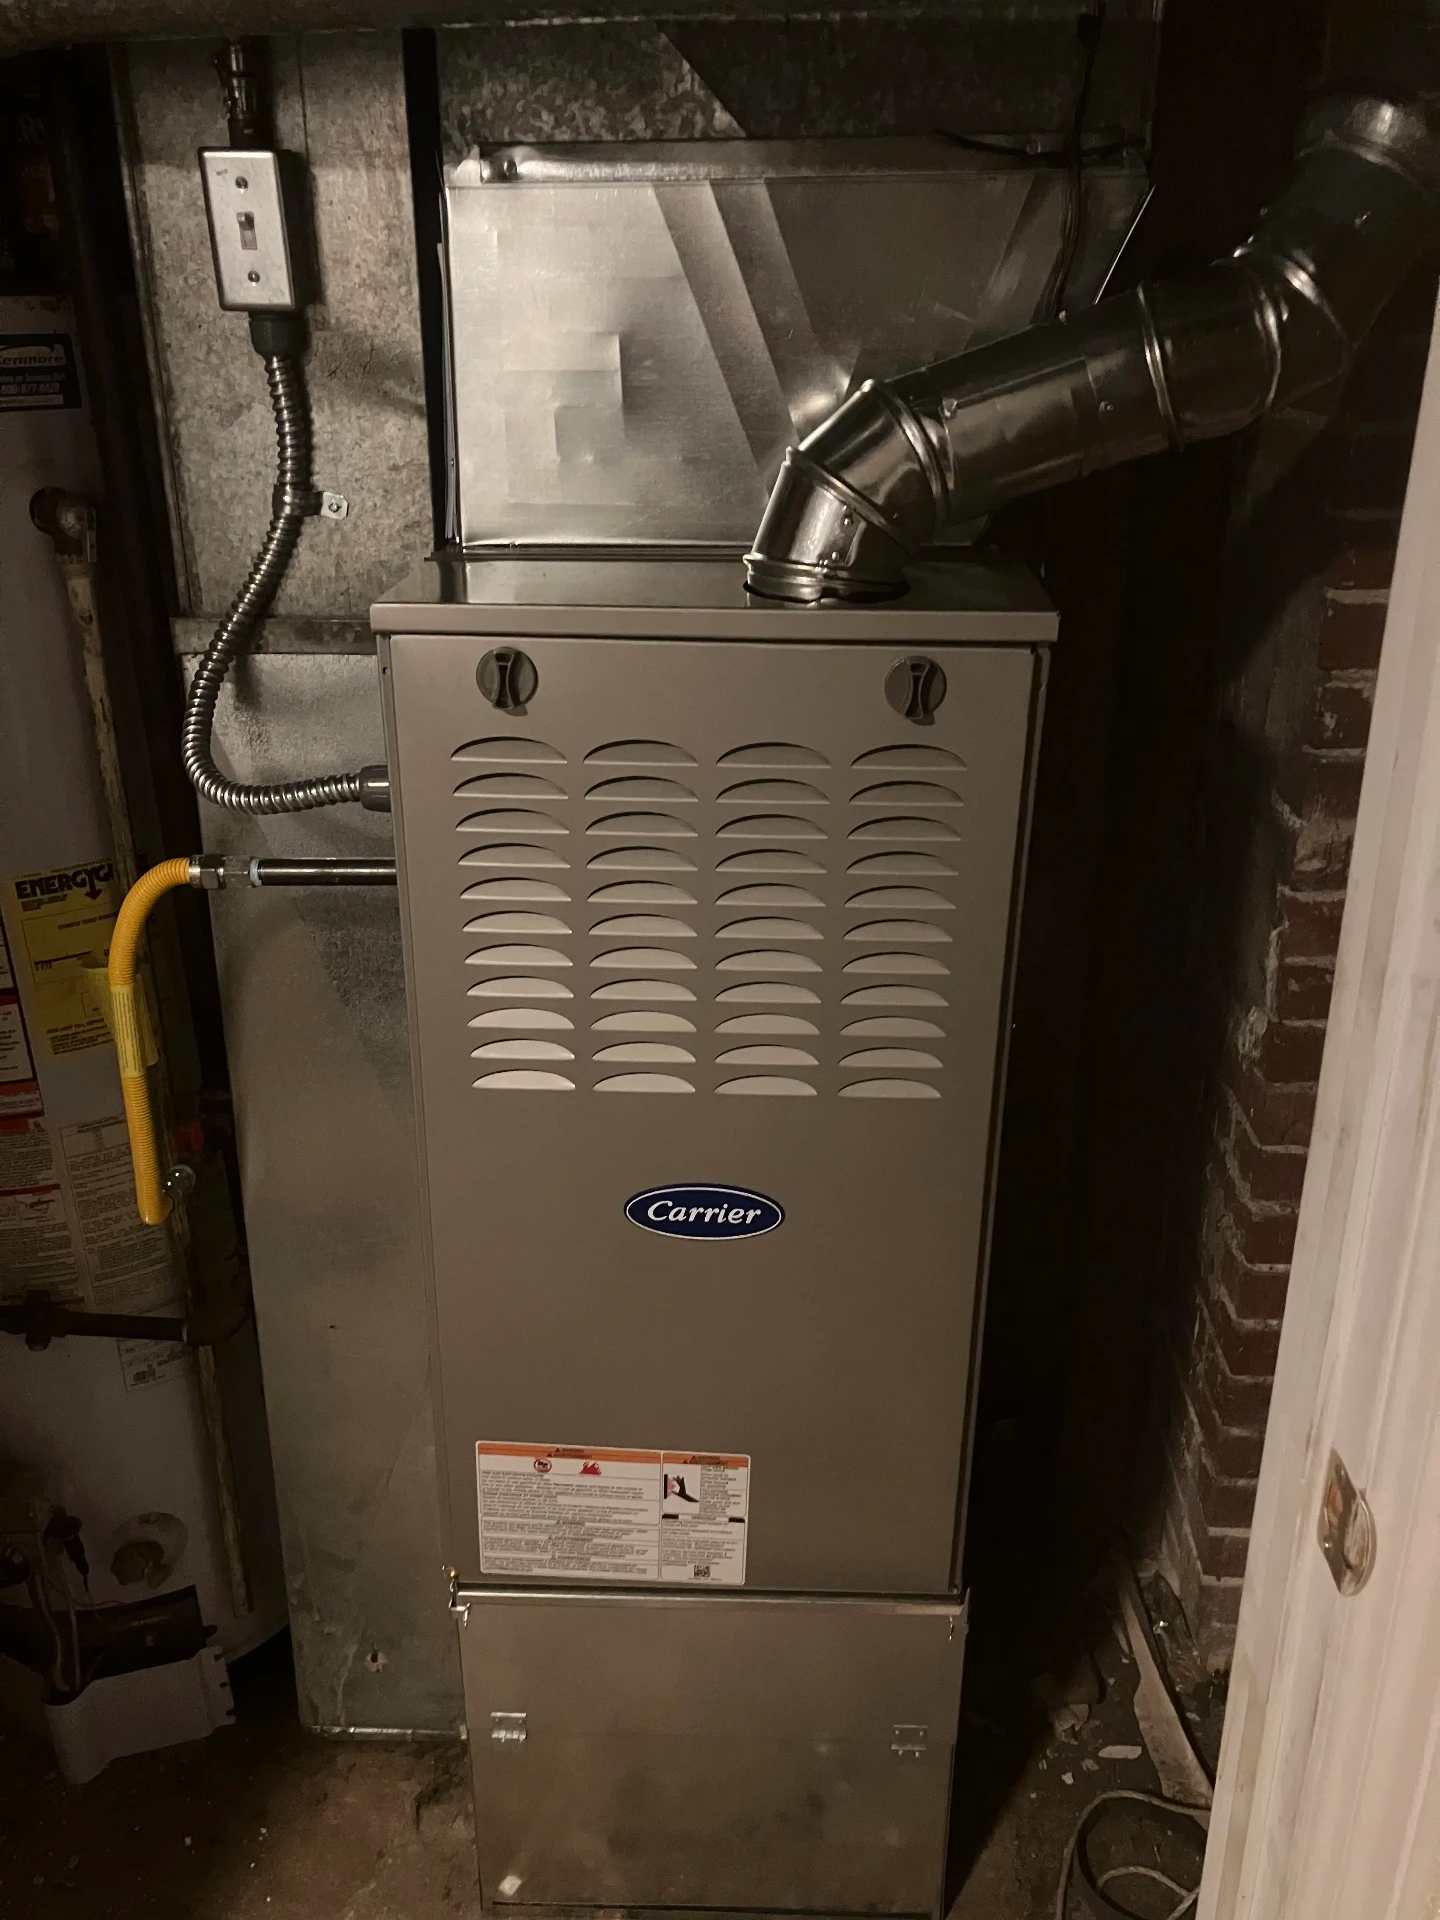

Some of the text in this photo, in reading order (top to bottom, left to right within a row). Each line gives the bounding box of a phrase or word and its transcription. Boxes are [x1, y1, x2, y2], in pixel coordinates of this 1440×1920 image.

[0, 355, 63, 366] enmore
[15, 863, 115, 900] ENERGYG
[647, 1200, 762, 1224] Carrier
